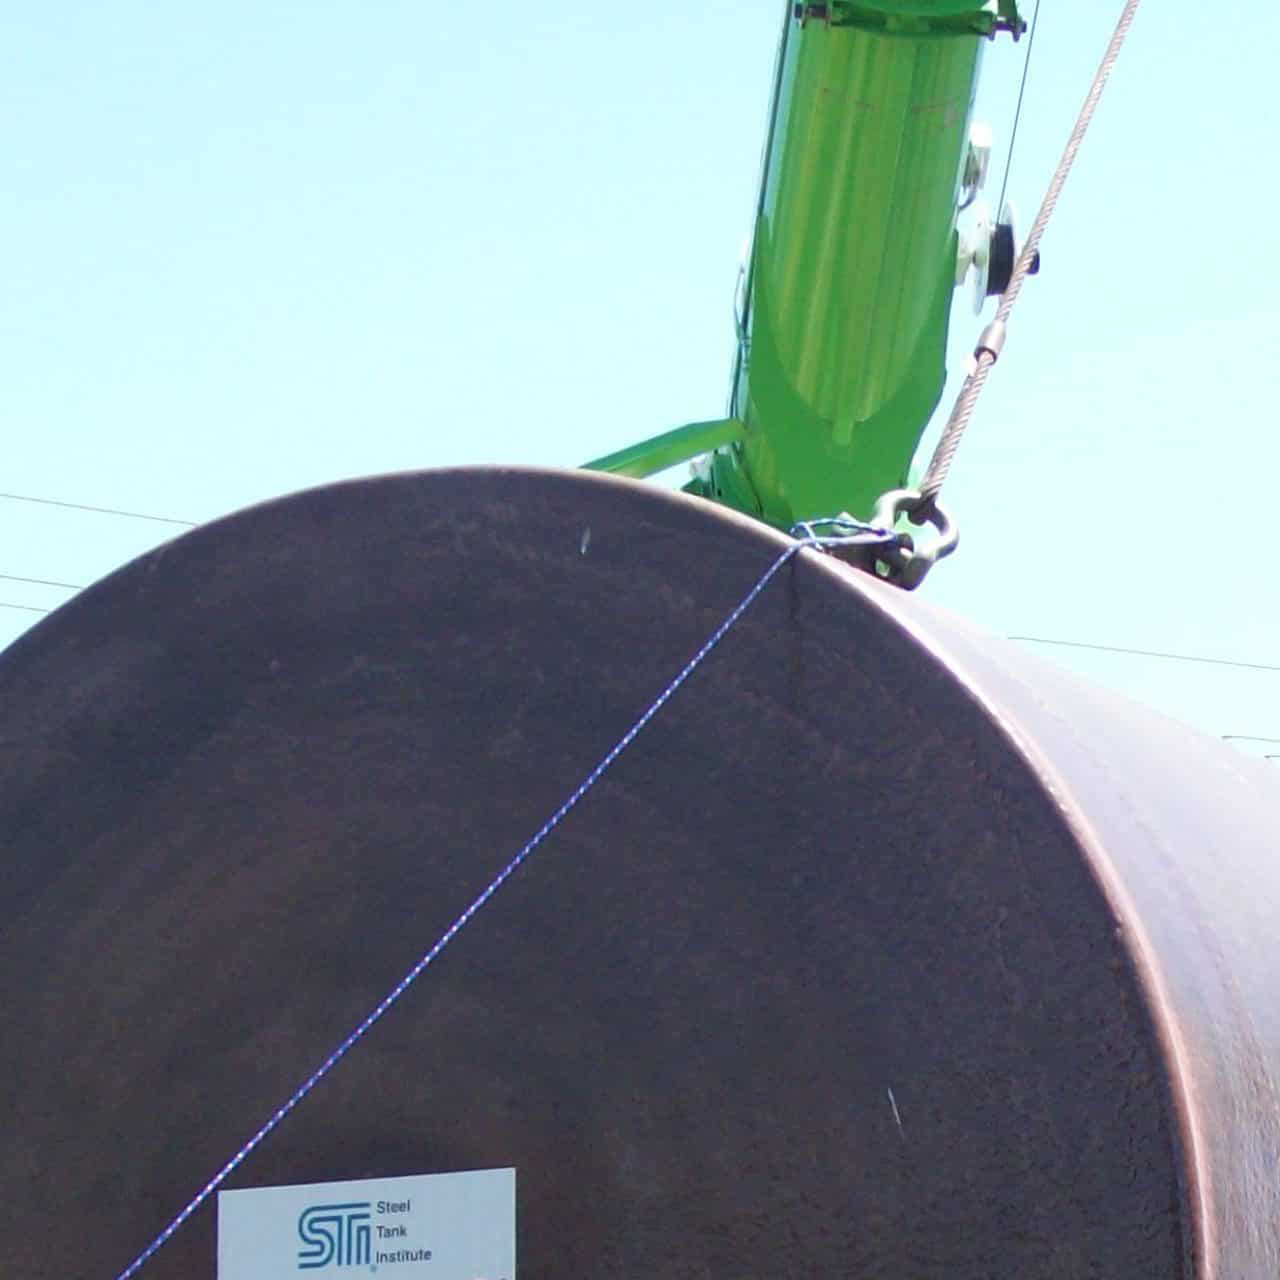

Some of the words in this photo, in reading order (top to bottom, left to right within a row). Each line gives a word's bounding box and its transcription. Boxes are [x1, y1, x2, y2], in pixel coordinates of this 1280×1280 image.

[376, 1199, 411, 1214] Steel
[376, 1225, 407, 1239] Tank
[376, 1248, 432, 1264] Institute
